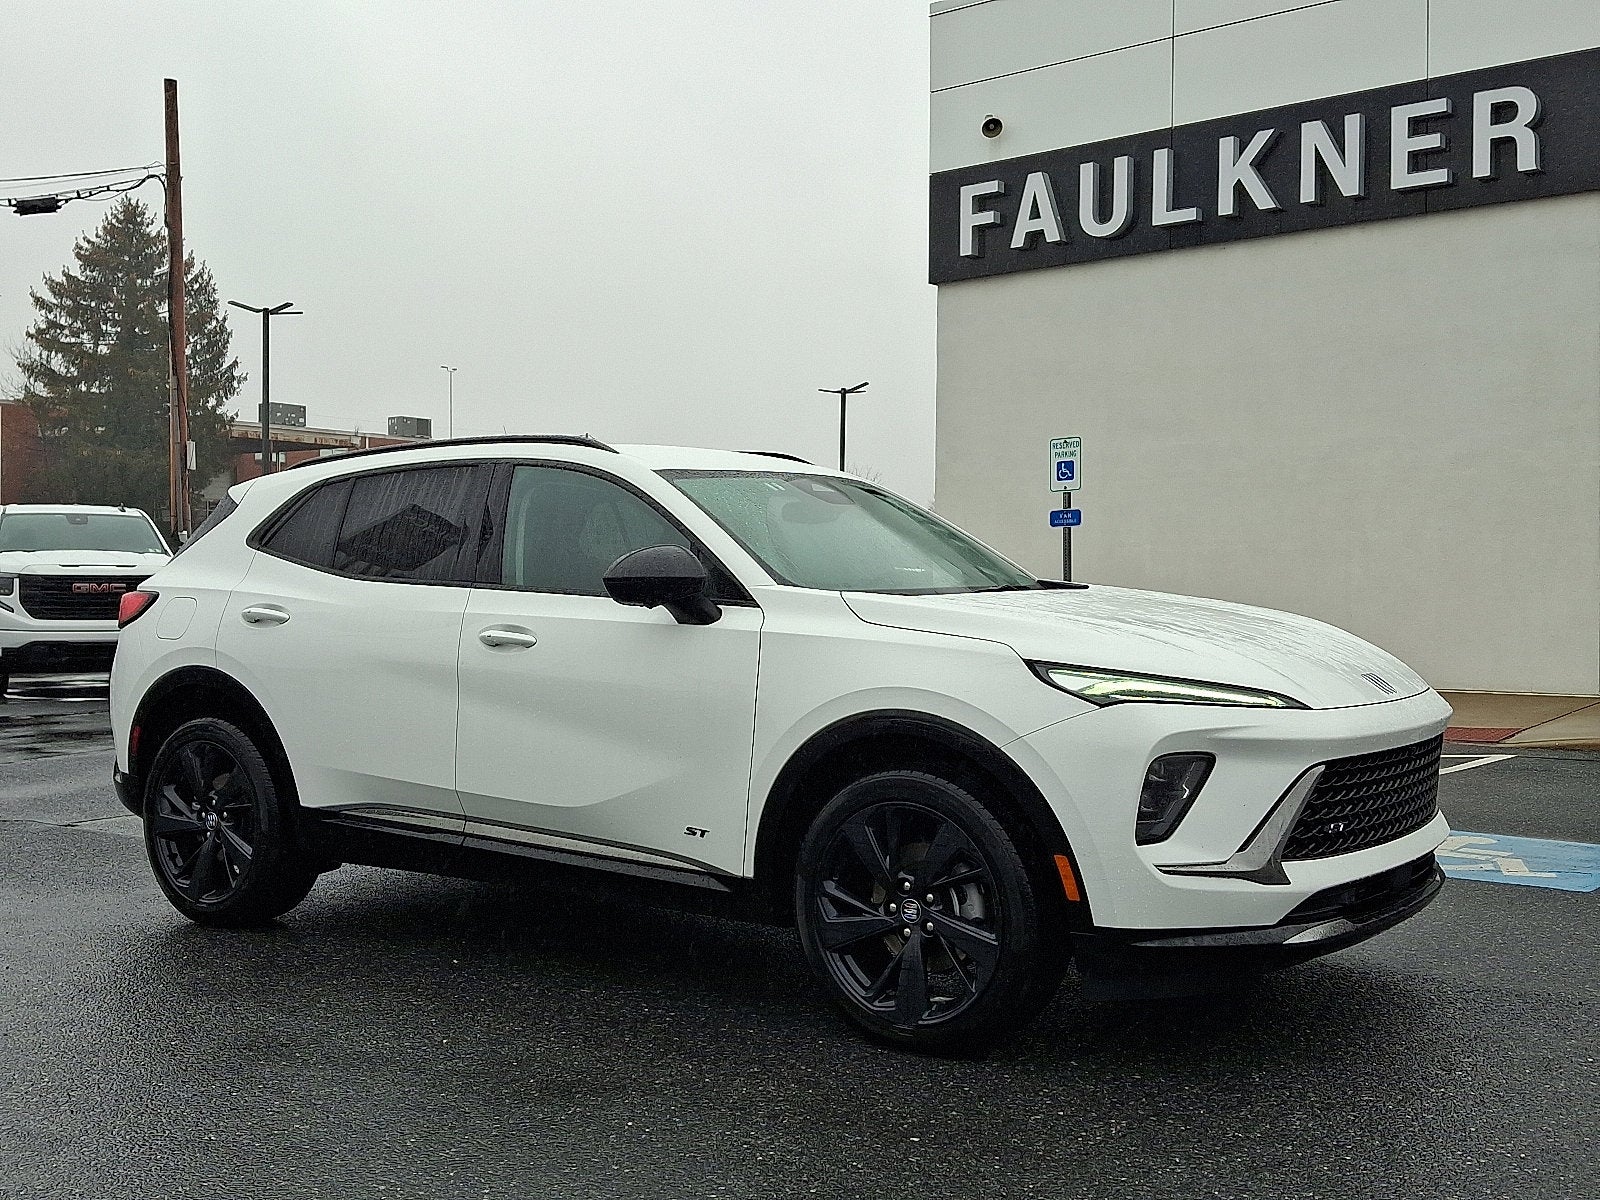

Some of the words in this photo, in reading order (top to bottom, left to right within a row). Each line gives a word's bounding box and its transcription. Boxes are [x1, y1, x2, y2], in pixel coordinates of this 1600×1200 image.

[958, 85, 1541, 258] FAULKNER
[1052, 440, 1080, 450] RESERVED
[1054, 450, 1077, 459] PARKING
[72, 583, 127, 593] GMC
[684, 826, 710, 838] ST
